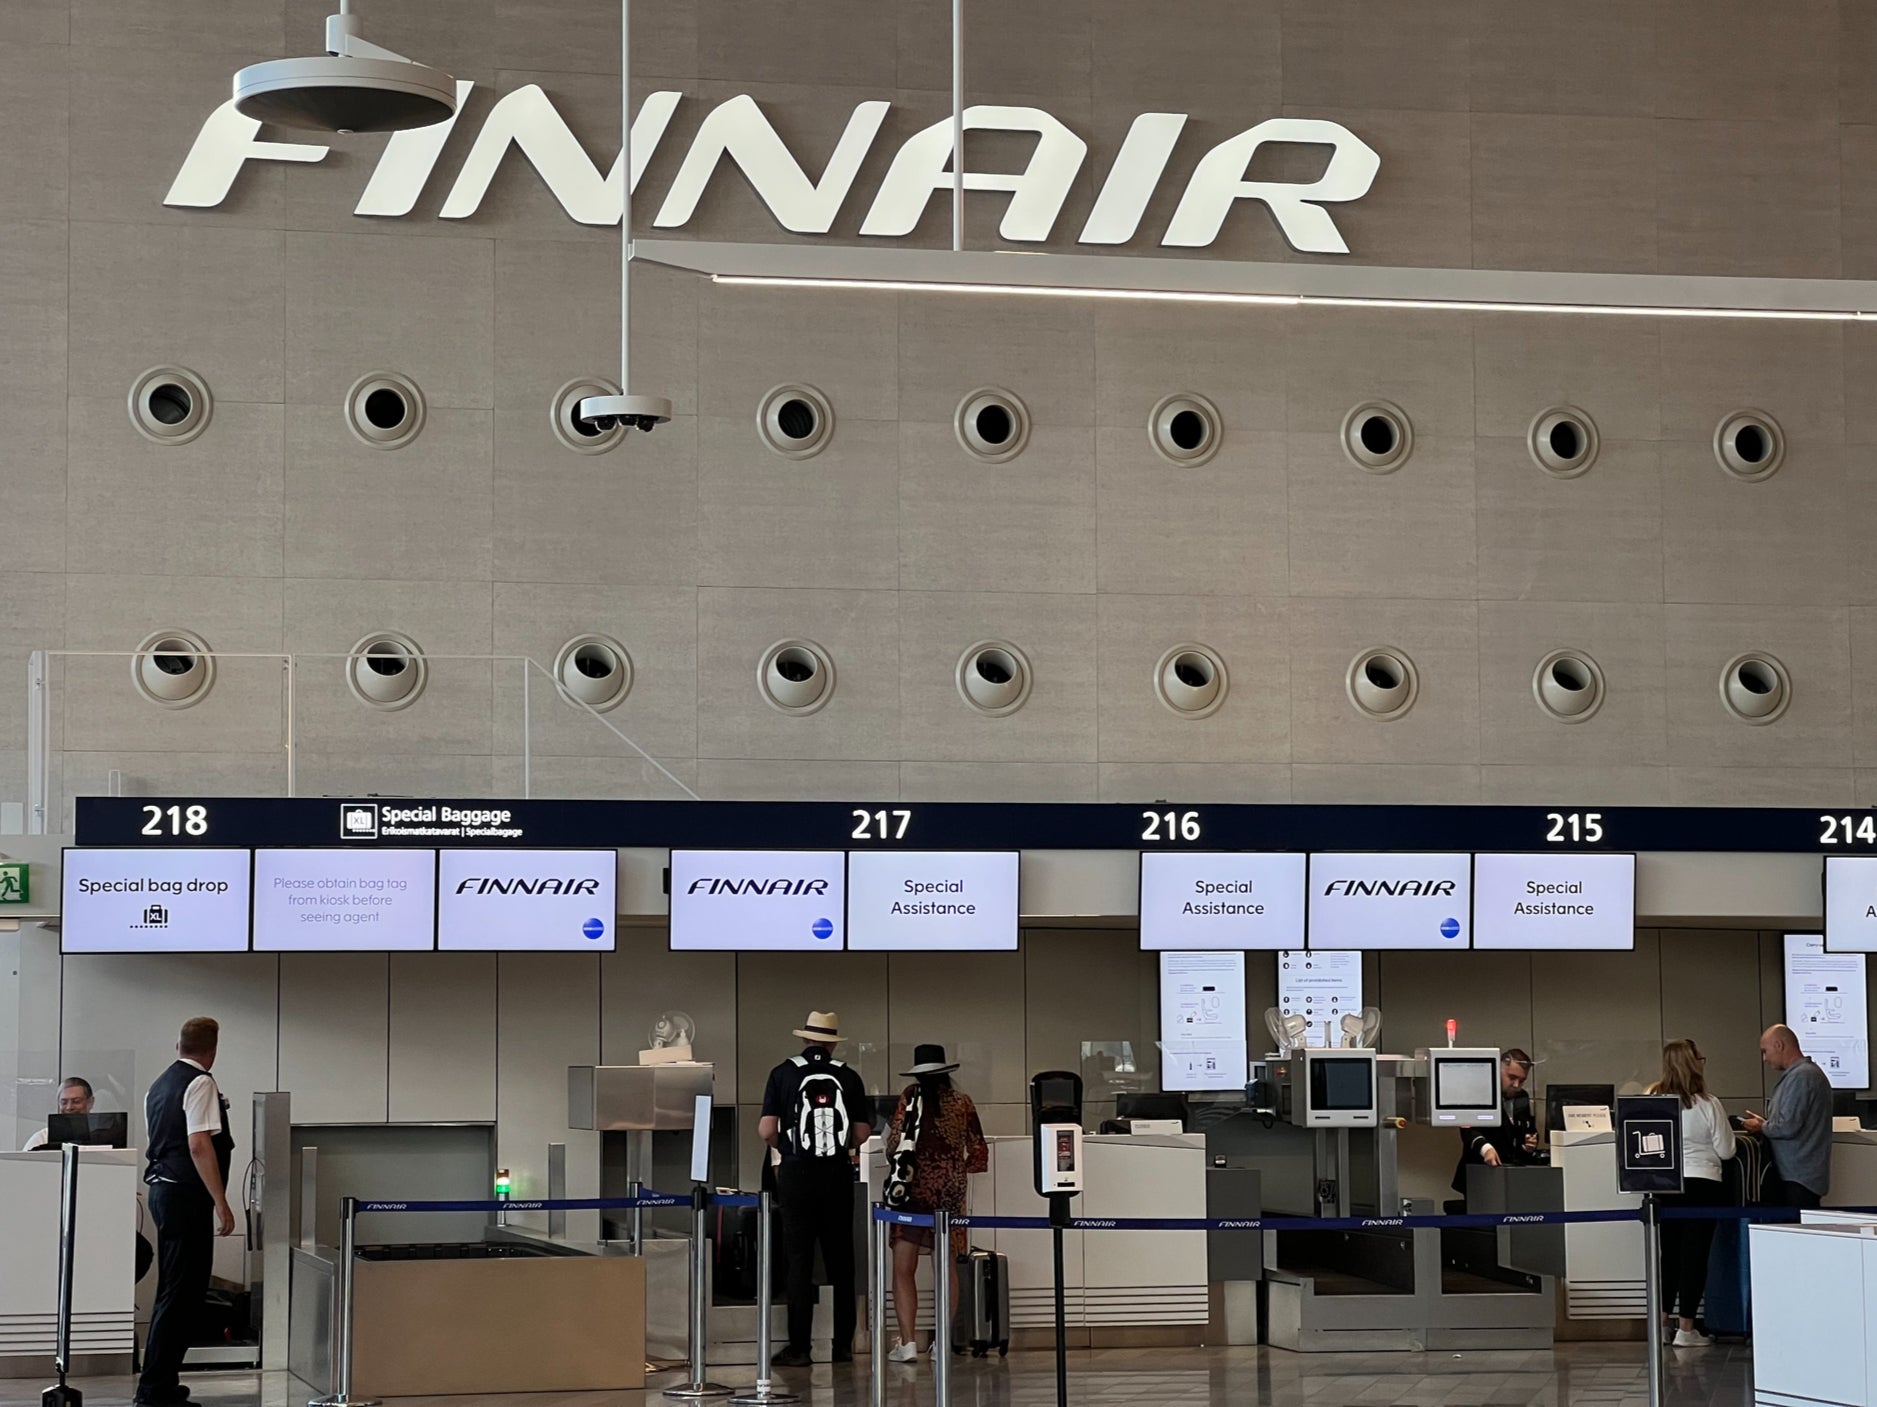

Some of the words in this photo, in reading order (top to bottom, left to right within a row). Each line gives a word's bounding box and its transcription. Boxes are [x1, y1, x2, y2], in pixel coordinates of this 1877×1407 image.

[163, 80, 1383, 255] FINNAIR
[141, 805, 208, 836] 218
[381, 806, 437, 825] Special
[441, 806, 512, 826] Baggage
[851, 809, 912, 840] 217
[1141, 811, 1201, 841] 216
[1546, 813, 1604, 842] 215
[1819, 815, 1877, 844] 214
[79, 877, 144, 896] Special
[148, 877, 184, 897] bag
[187, 877, 229, 897] drop
[273, 877, 315, 889] Please
[317, 877, 358, 889] obtain
[360, 877, 385, 892] bag
[386, 878, 408, 892] tag
[455, 878, 600, 896] FINNAIR
[687, 878, 829, 896] FINNAIR
[903, 879, 964, 895] Special
[1195, 880, 1253, 896] Special
[1324, 879, 1457, 897] FINNAIR
[1526, 880, 1583, 897] Special
[287, 894, 317, 906] from
[319, 894, 350, 906] kiosk
[352, 893, 393, 906] before
[890, 900, 977, 916] Assistance
[1182, 901, 1265, 917] Assistance
[1513, 902, 1595, 917] Assistance
[150, 912, 162, 921] XL
[300, 911, 340, 926] seeing
[342, 911, 380, 926] agent
[1074, 1220, 1117, 1228] FINNAIR
[1218, 1220, 1261, 1228] FINNAIR
[1361, 1218, 1404, 1227] FINNAIR
[1503, 1214, 1545, 1223] FINNAIR
